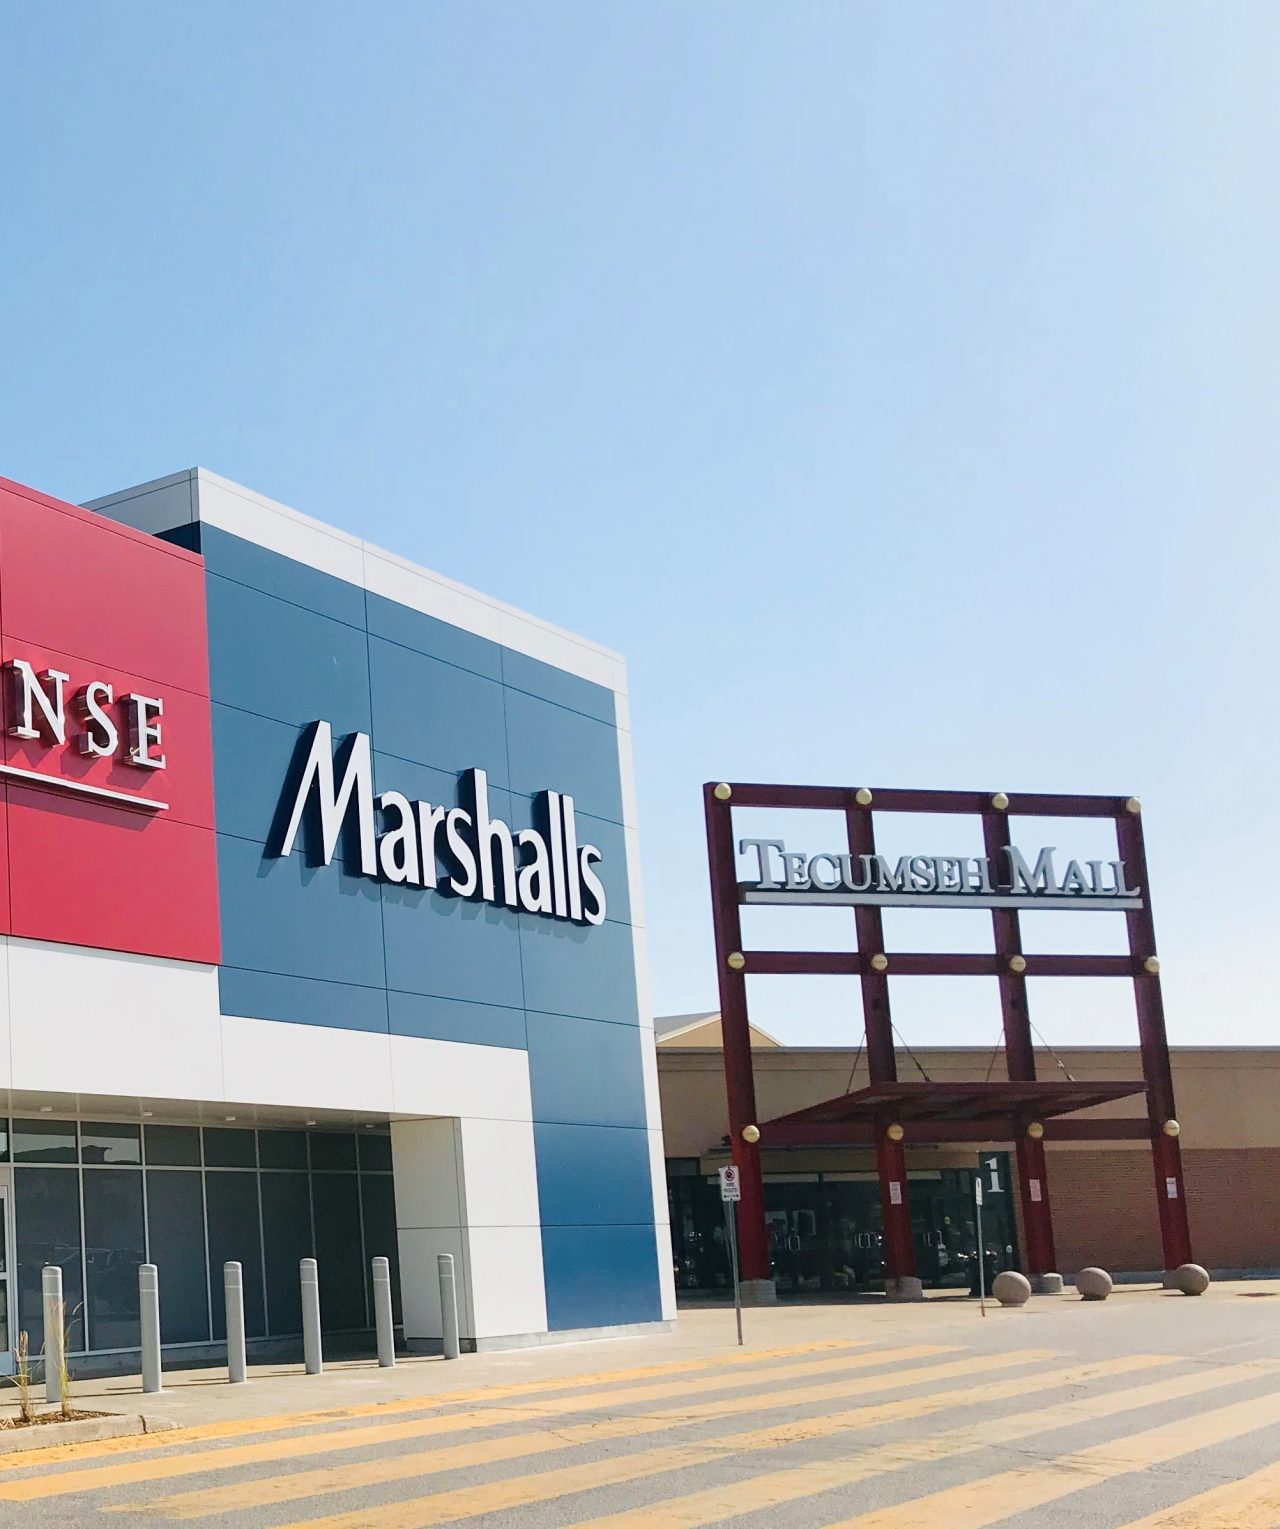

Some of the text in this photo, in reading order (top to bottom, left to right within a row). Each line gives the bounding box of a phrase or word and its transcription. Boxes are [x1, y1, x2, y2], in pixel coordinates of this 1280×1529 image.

[273, 719, 607, 926] Marshalls
[739, 837, 1141, 898] TECUMSEH MALL
